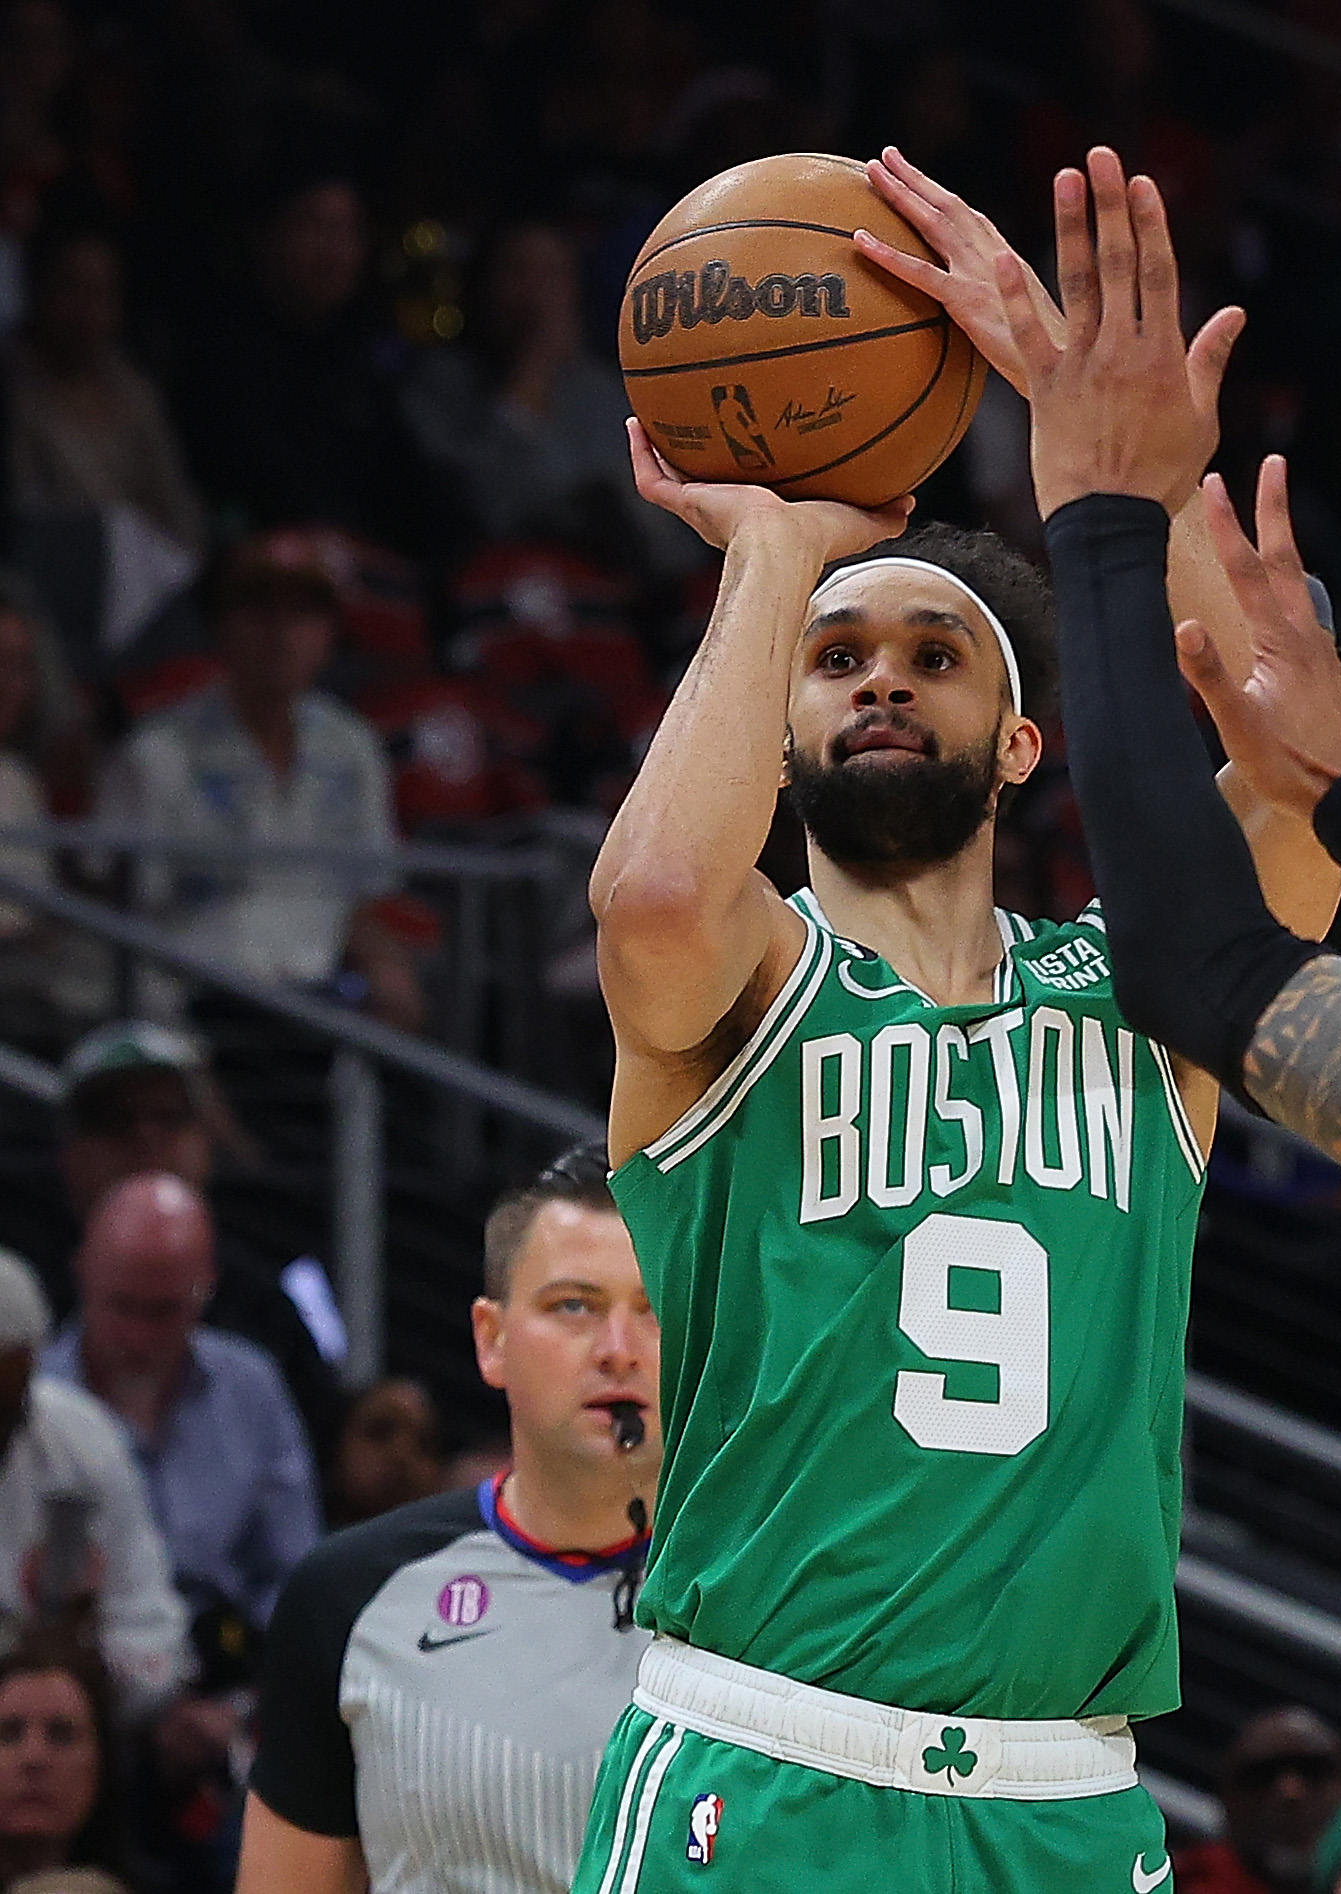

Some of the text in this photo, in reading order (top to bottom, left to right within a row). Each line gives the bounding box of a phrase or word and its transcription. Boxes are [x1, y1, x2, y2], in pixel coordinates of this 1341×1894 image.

[632, 258, 850, 345] Wilson
[799, 1004, 1135, 1224] BOSTON
[892, 1212, 1050, 1457] 9
